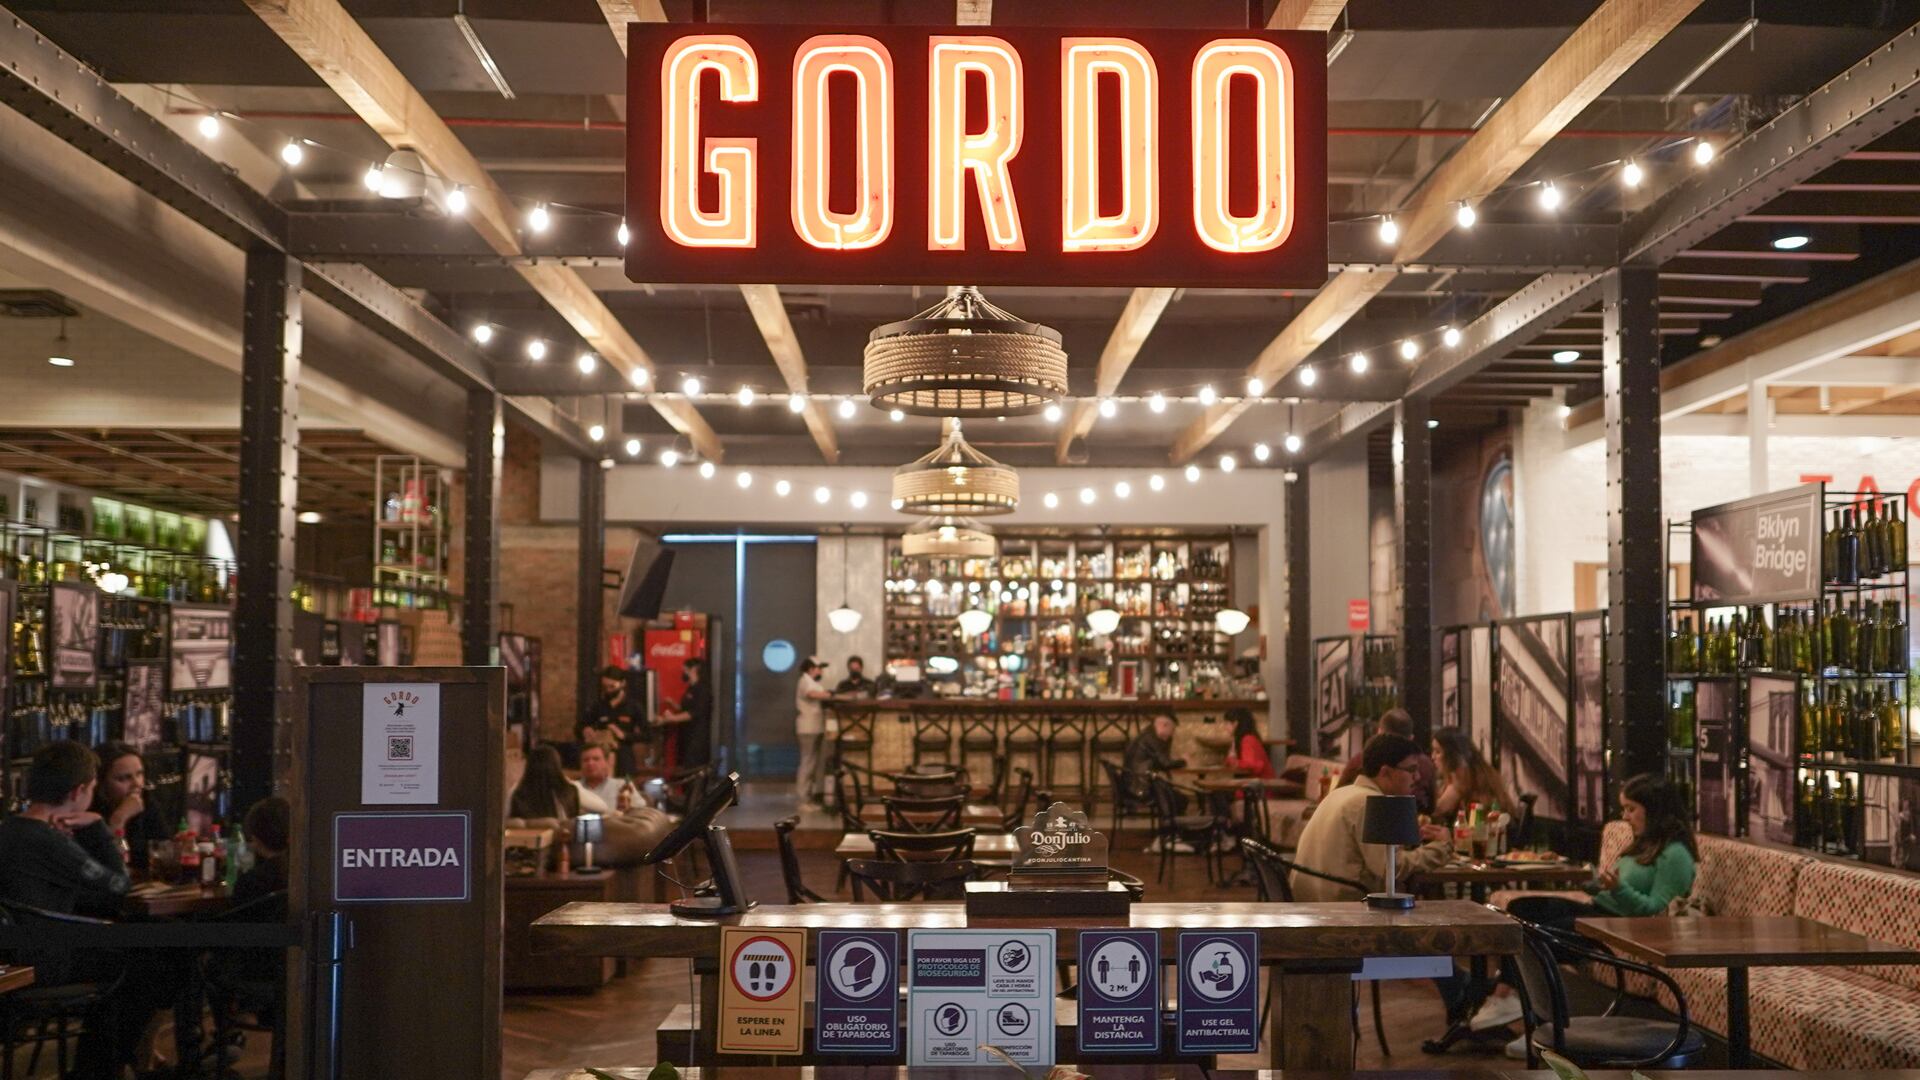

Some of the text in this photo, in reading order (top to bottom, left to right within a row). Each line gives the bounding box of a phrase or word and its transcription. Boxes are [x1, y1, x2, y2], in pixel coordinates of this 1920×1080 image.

[661, 34, 1295, 253] GORDO
[1757, 514, 1800, 543] Bklyn
[1755, 543, 1806, 578] Bridge
[383, 690, 420, 705] GORDO
[342, 847, 460, 868] ENTRADA
[737, 1016, 771, 1025] ESPERE
[825, 1023, 888, 1031] OBLIGATORIO
[740, 1028, 753, 1036] LA
[1094, 1031, 1144, 1039] DISTANCIA
